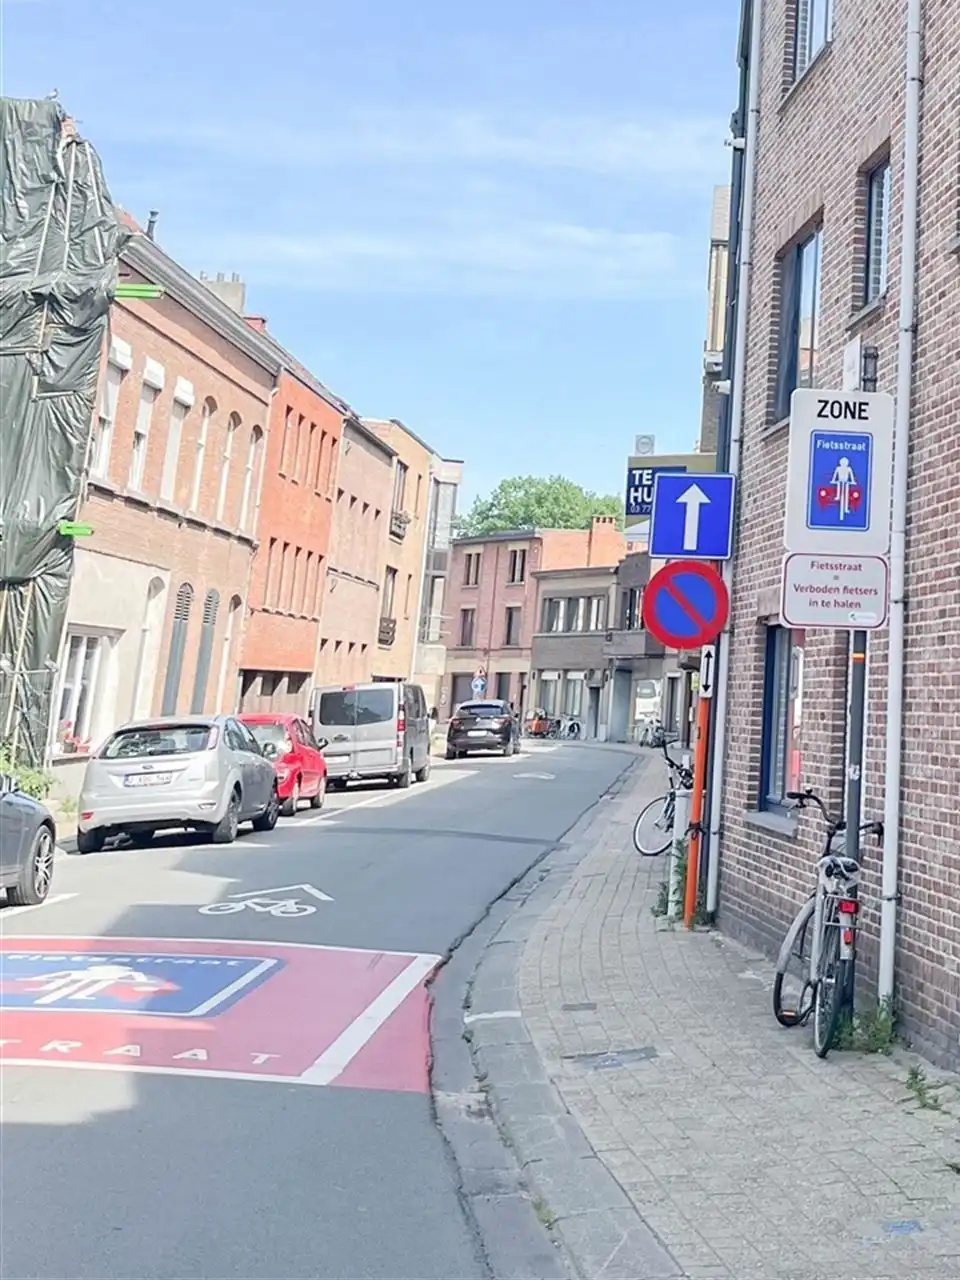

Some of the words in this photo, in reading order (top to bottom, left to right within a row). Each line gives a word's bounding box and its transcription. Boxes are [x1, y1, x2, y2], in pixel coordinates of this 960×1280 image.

[816, 399, 870, 421] ZONE
[816, 439, 867, 452] Fietsstraat
[632, 469, 653, 485] TE
[810, 560, 863, 572] Fietsstraat
[793, 583, 840, 594] Verboden
[843, 585, 878, 596] fietsers
[808, 598, 818, 608] in
[821, 599, 831, 609] te
[834, 599, 861, 609] halen
